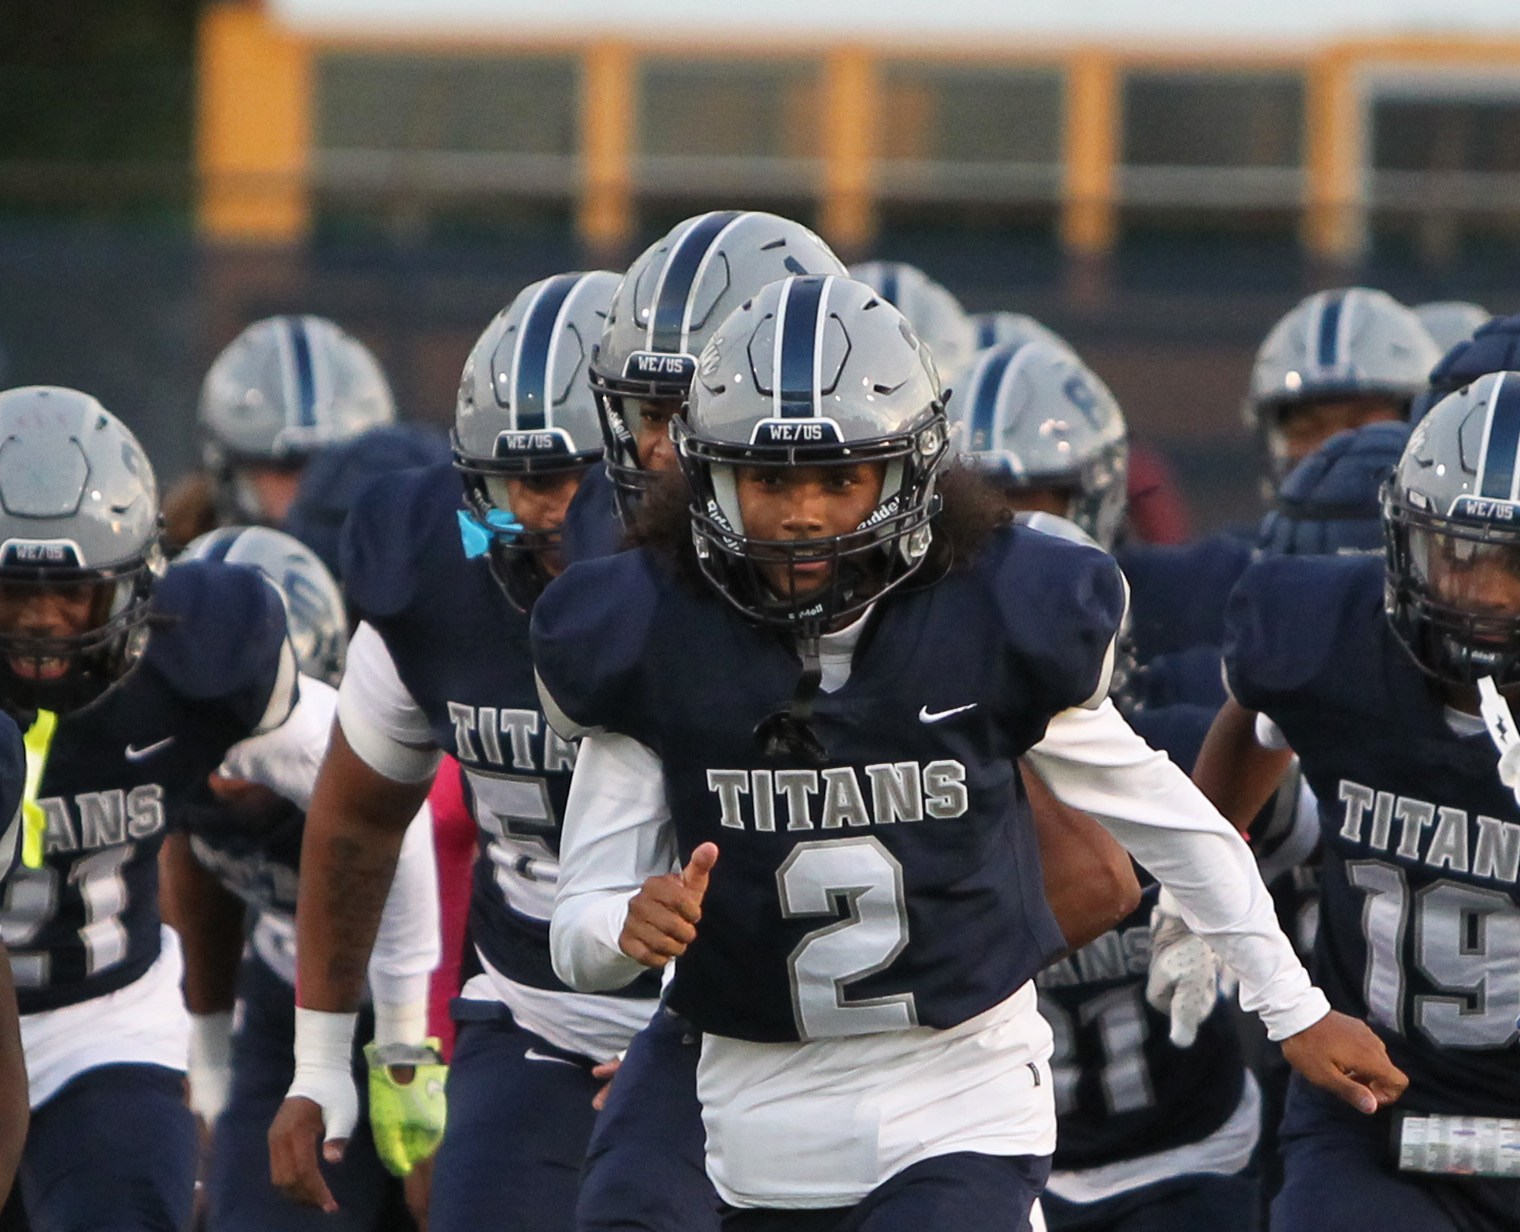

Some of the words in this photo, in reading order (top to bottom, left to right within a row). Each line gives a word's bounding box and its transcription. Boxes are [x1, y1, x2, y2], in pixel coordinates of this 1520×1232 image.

[638, 356, 684, 373] WE/US
[507, 434, 554, 450] WE/US
[769, 425, 822, 440] WE/US
[1466, 501, 1514, 520] WE/US
[446, 701, 579, 771] TITA
[34, 783, 166, 855] ANS
[706, 759, 969, 832] TITANS
[776, 835, 919, 1042] 2
[1037, 926, 1151, 988] ANS
